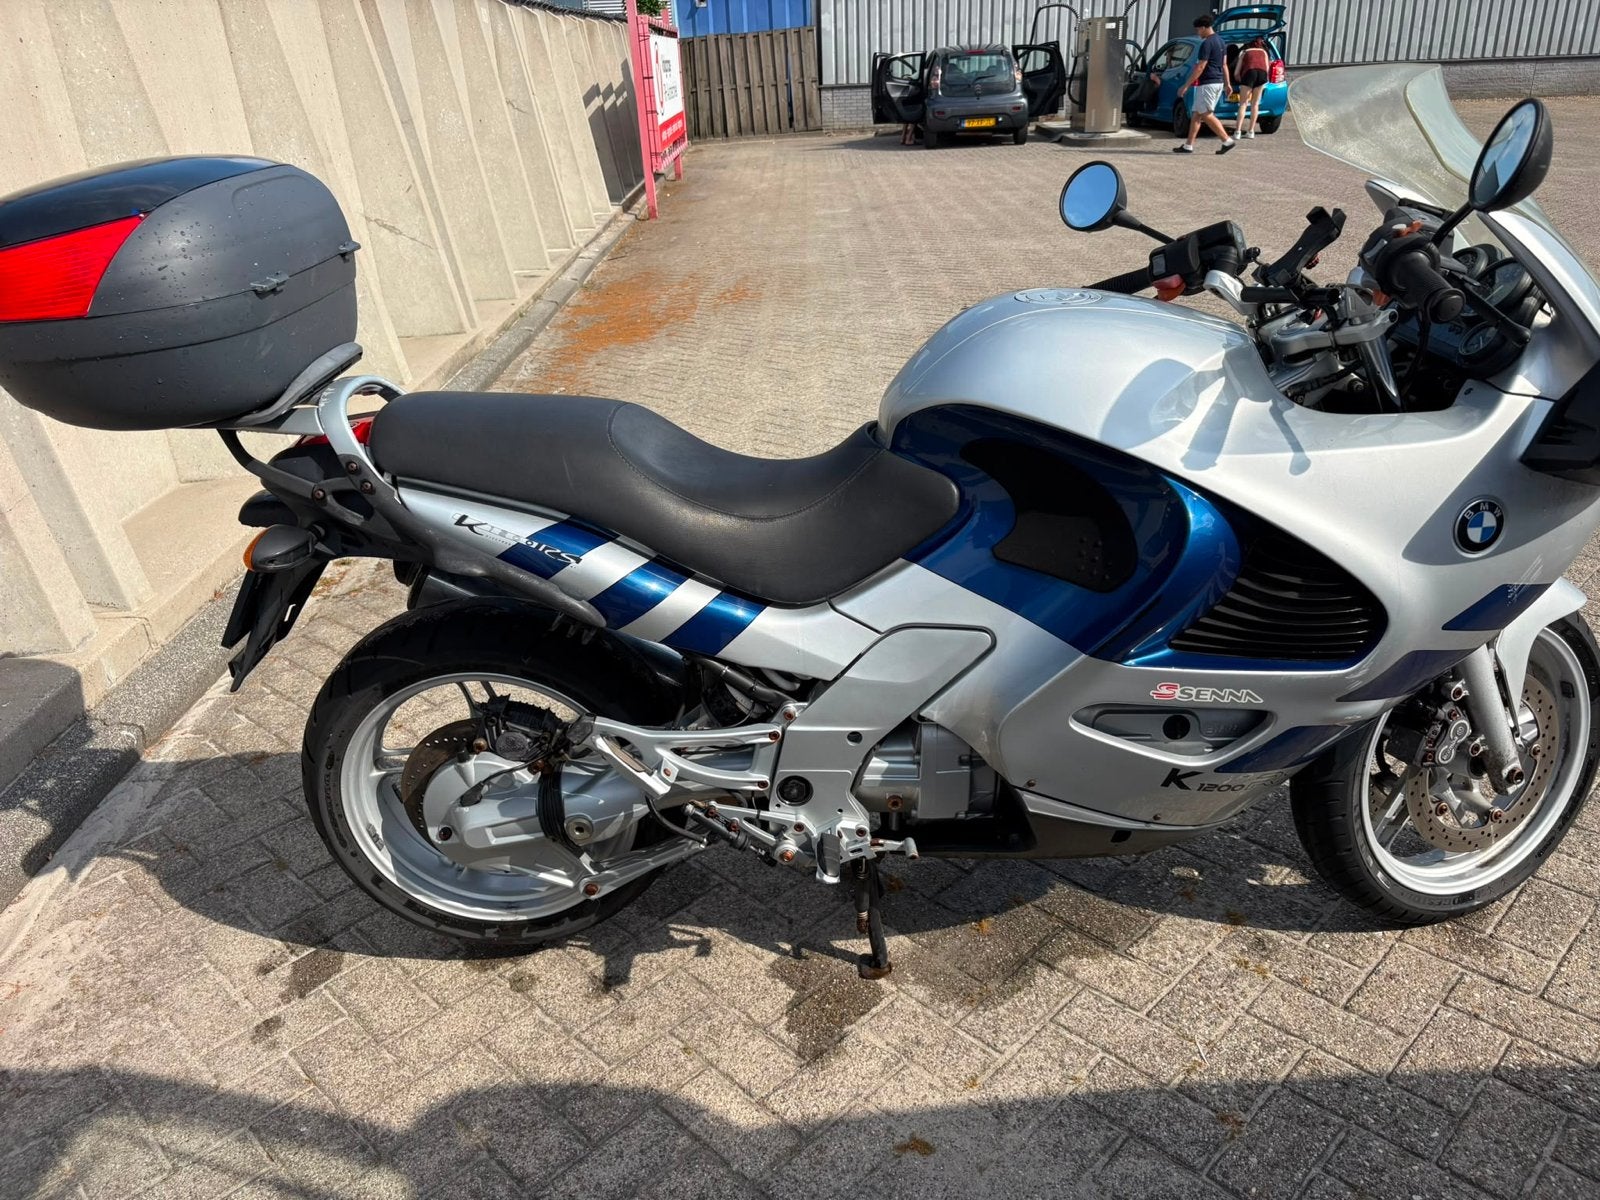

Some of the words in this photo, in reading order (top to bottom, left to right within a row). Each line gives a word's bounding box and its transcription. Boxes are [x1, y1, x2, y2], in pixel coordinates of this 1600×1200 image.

[1464, 503, 1501, 519] BMW
[1177, 686, 1264, 704] SENNA
[1160, 767, 1204, 791] K
[1196, 783, 1245, 792] 1200
